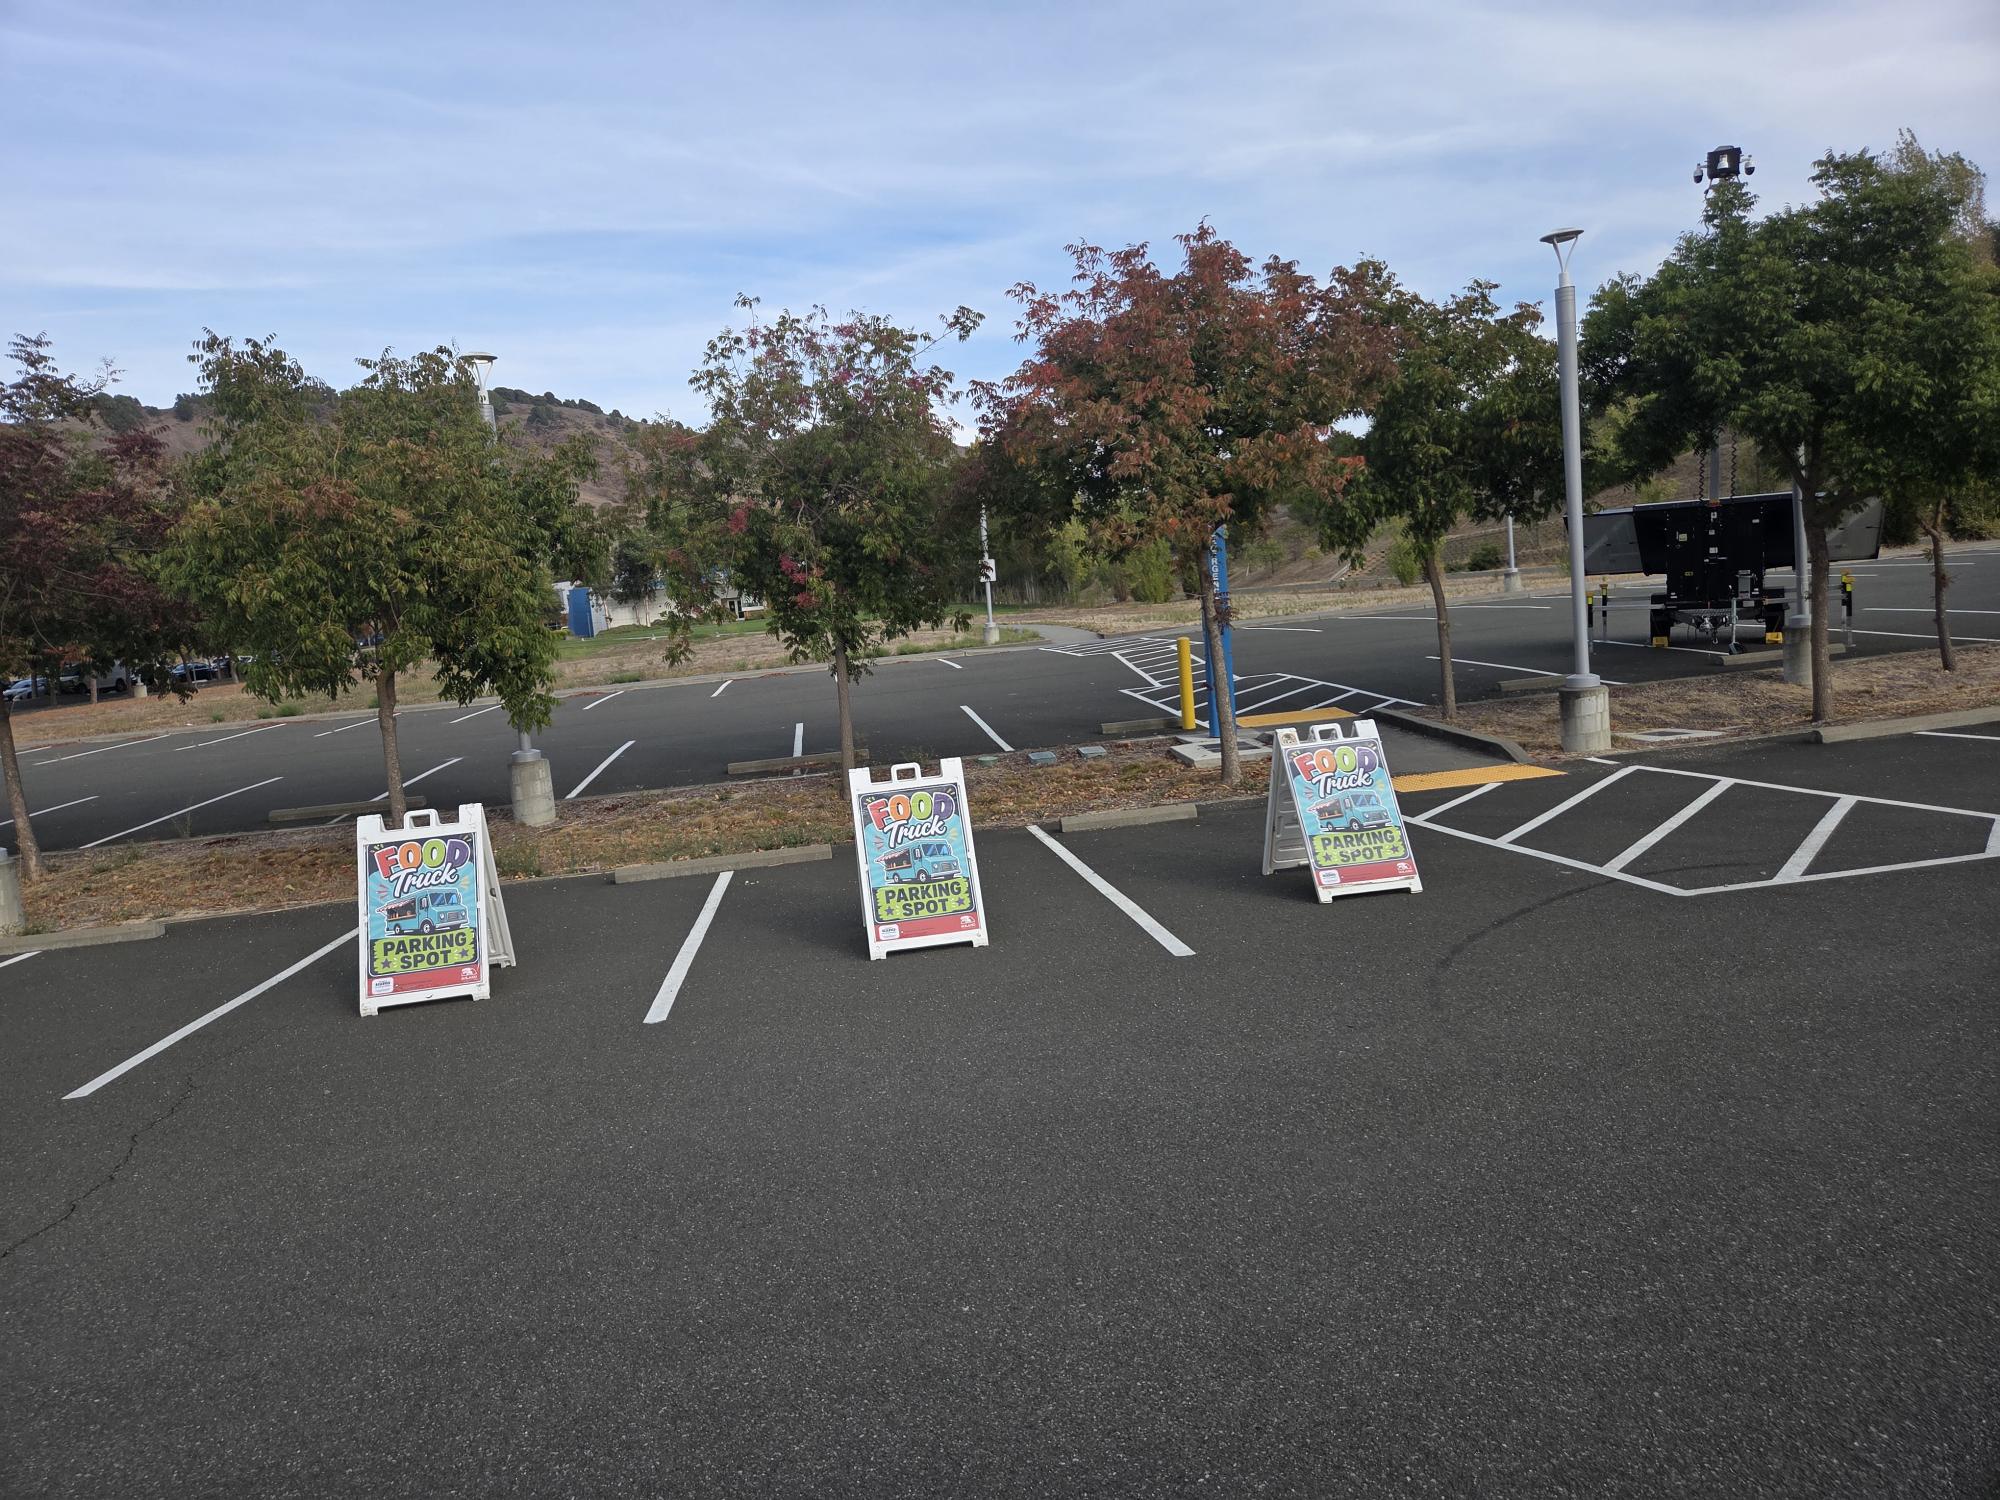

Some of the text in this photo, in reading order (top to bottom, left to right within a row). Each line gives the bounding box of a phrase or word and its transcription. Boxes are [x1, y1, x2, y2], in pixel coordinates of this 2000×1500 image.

[1294, 746, 1378, 781] FOOD
[1312, 767, 1373, 798] Truck
[868, 792, 955, 831] FOOD
[884, 815, 946, 848] Truck
[1321, 829, 1394, 850] PARKING
[374, 839, 470, 880] FOOD
[1340, 845, 1383, 863] SPOT
[389, 862, 458, 898] Truck
[885, 881, 961, 904] PARKING
[902, 898, 948, 916] SPOT
[383, 932, 467, 957] PARKING
[400, 950, 451, 970] SPOT
